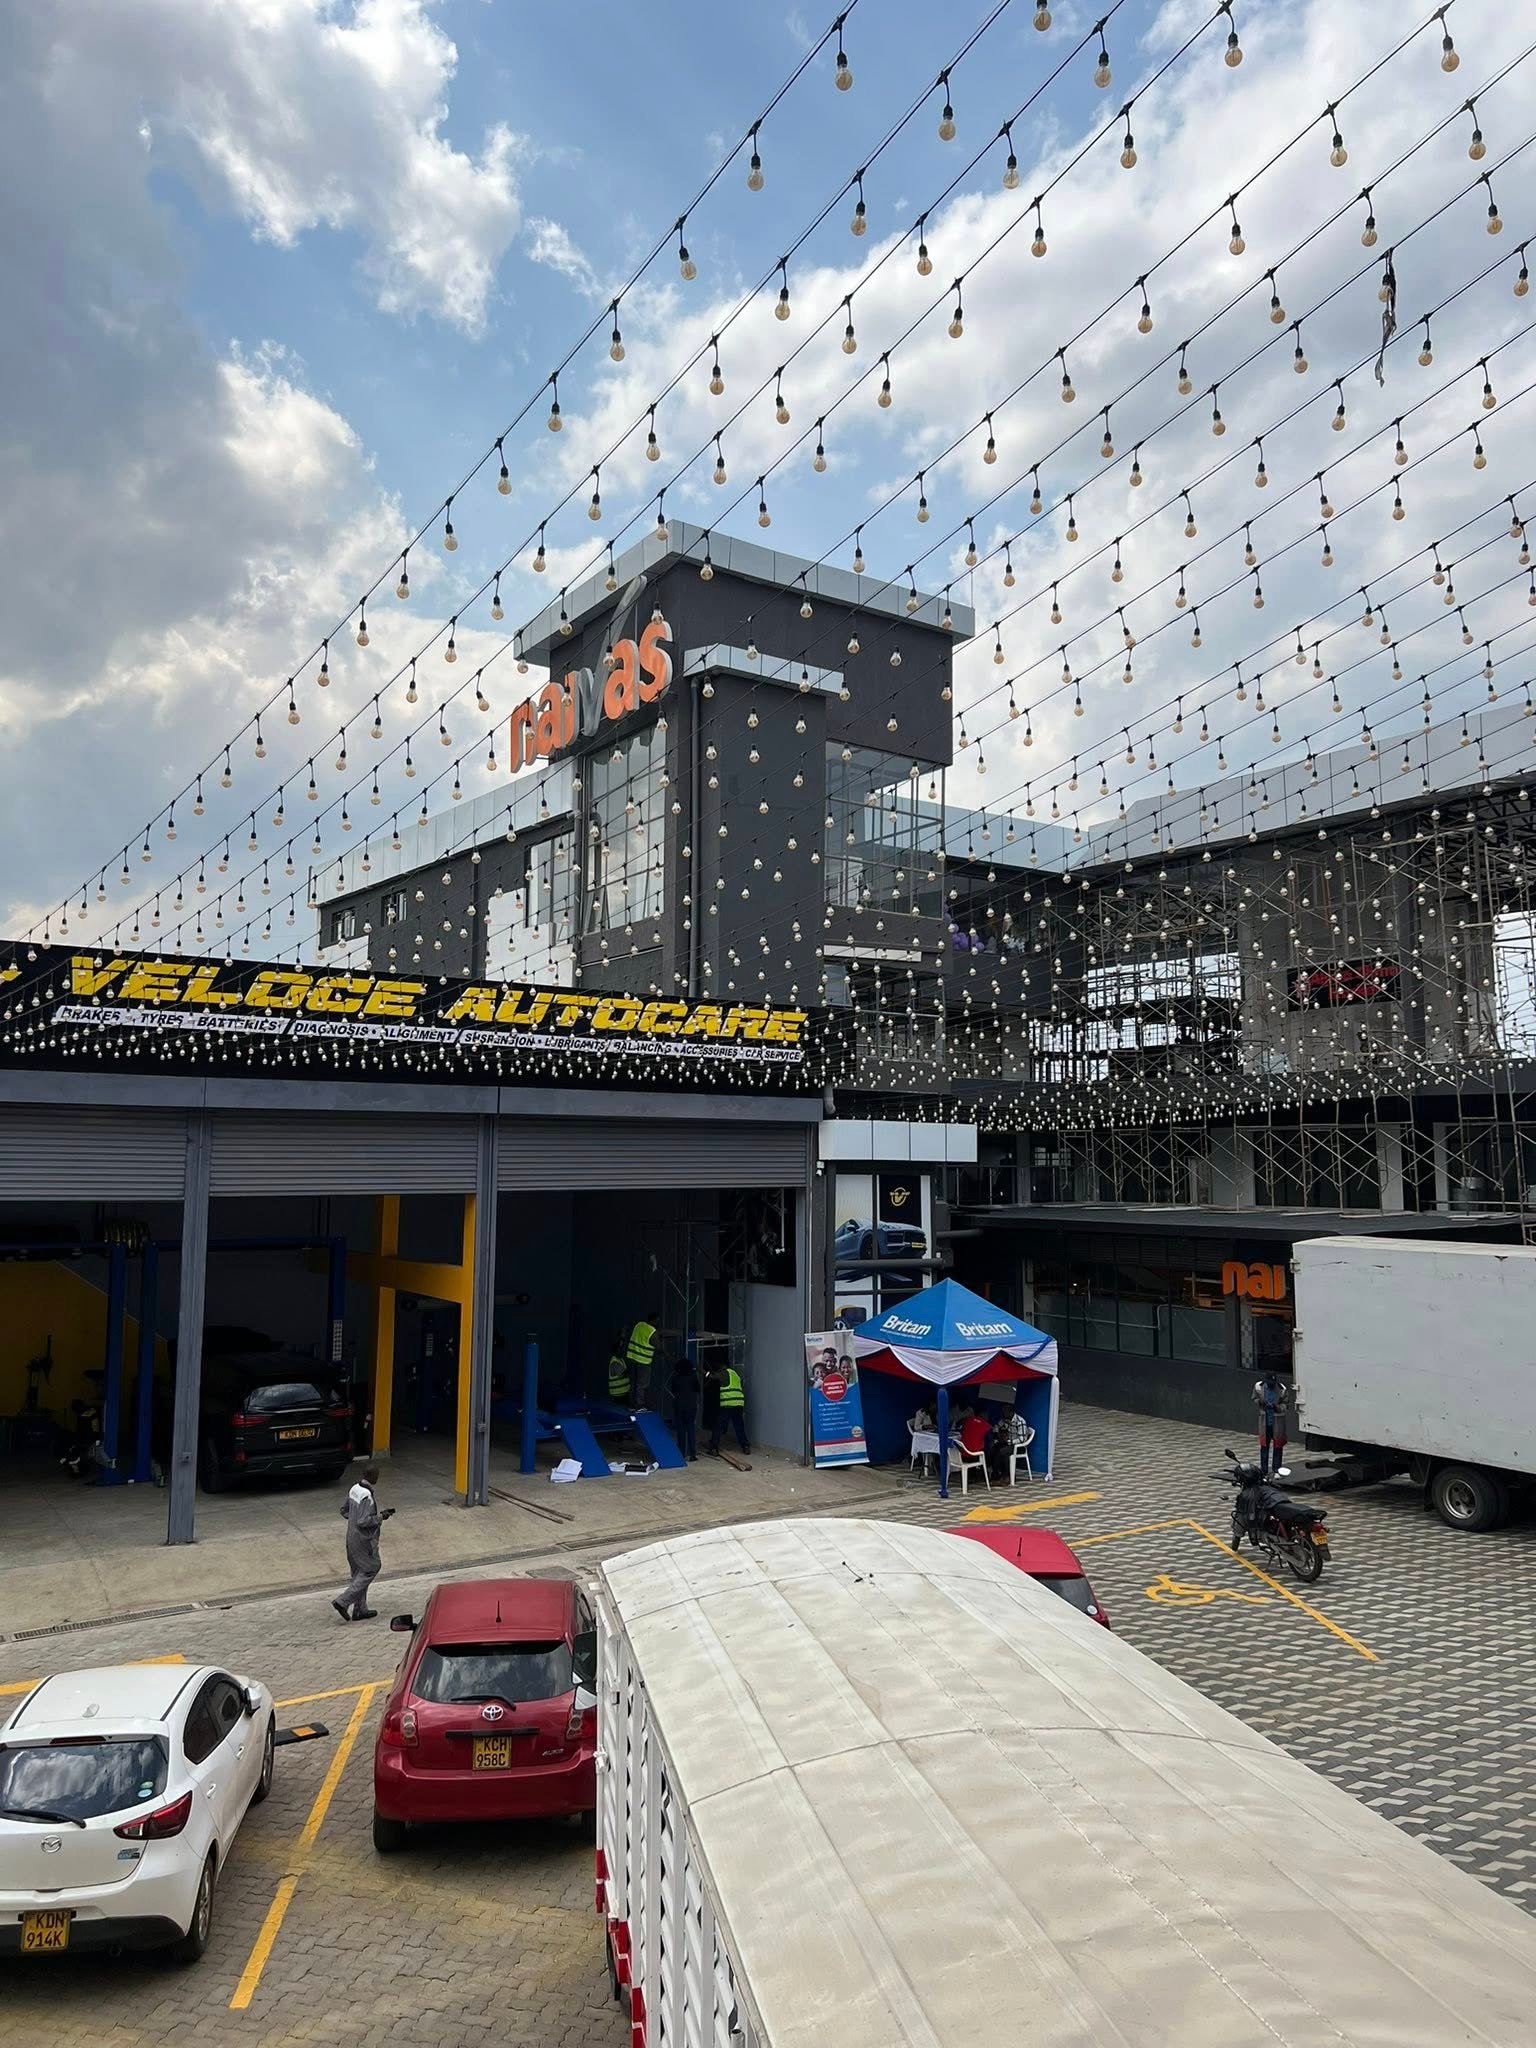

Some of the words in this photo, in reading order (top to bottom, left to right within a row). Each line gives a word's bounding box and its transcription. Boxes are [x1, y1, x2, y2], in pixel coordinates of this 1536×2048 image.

[511, 577, 673, 773] naivas
[71, 956, 428, 1016] VELOCE
[443, 986, 809, 1041] AUTOCARE
[61, 1006, 120, 1022] BRAKES
[140, 1012, 184, 1026] TYRES
[197, 1016, 278, 1032] BATTERIES
[294, 1021, 369, 1037] DIAGNOSIS
[883, 1315, 931, 1335] Britam
[956, 1322, 1013, 1336] Britam
[484, 1737, 507, 1752] KCH
[476, 1753, 506, 1767] 958C
[35, 1911, 66, 1929] KDN
[26, 1930, 63, 1948] 914K
